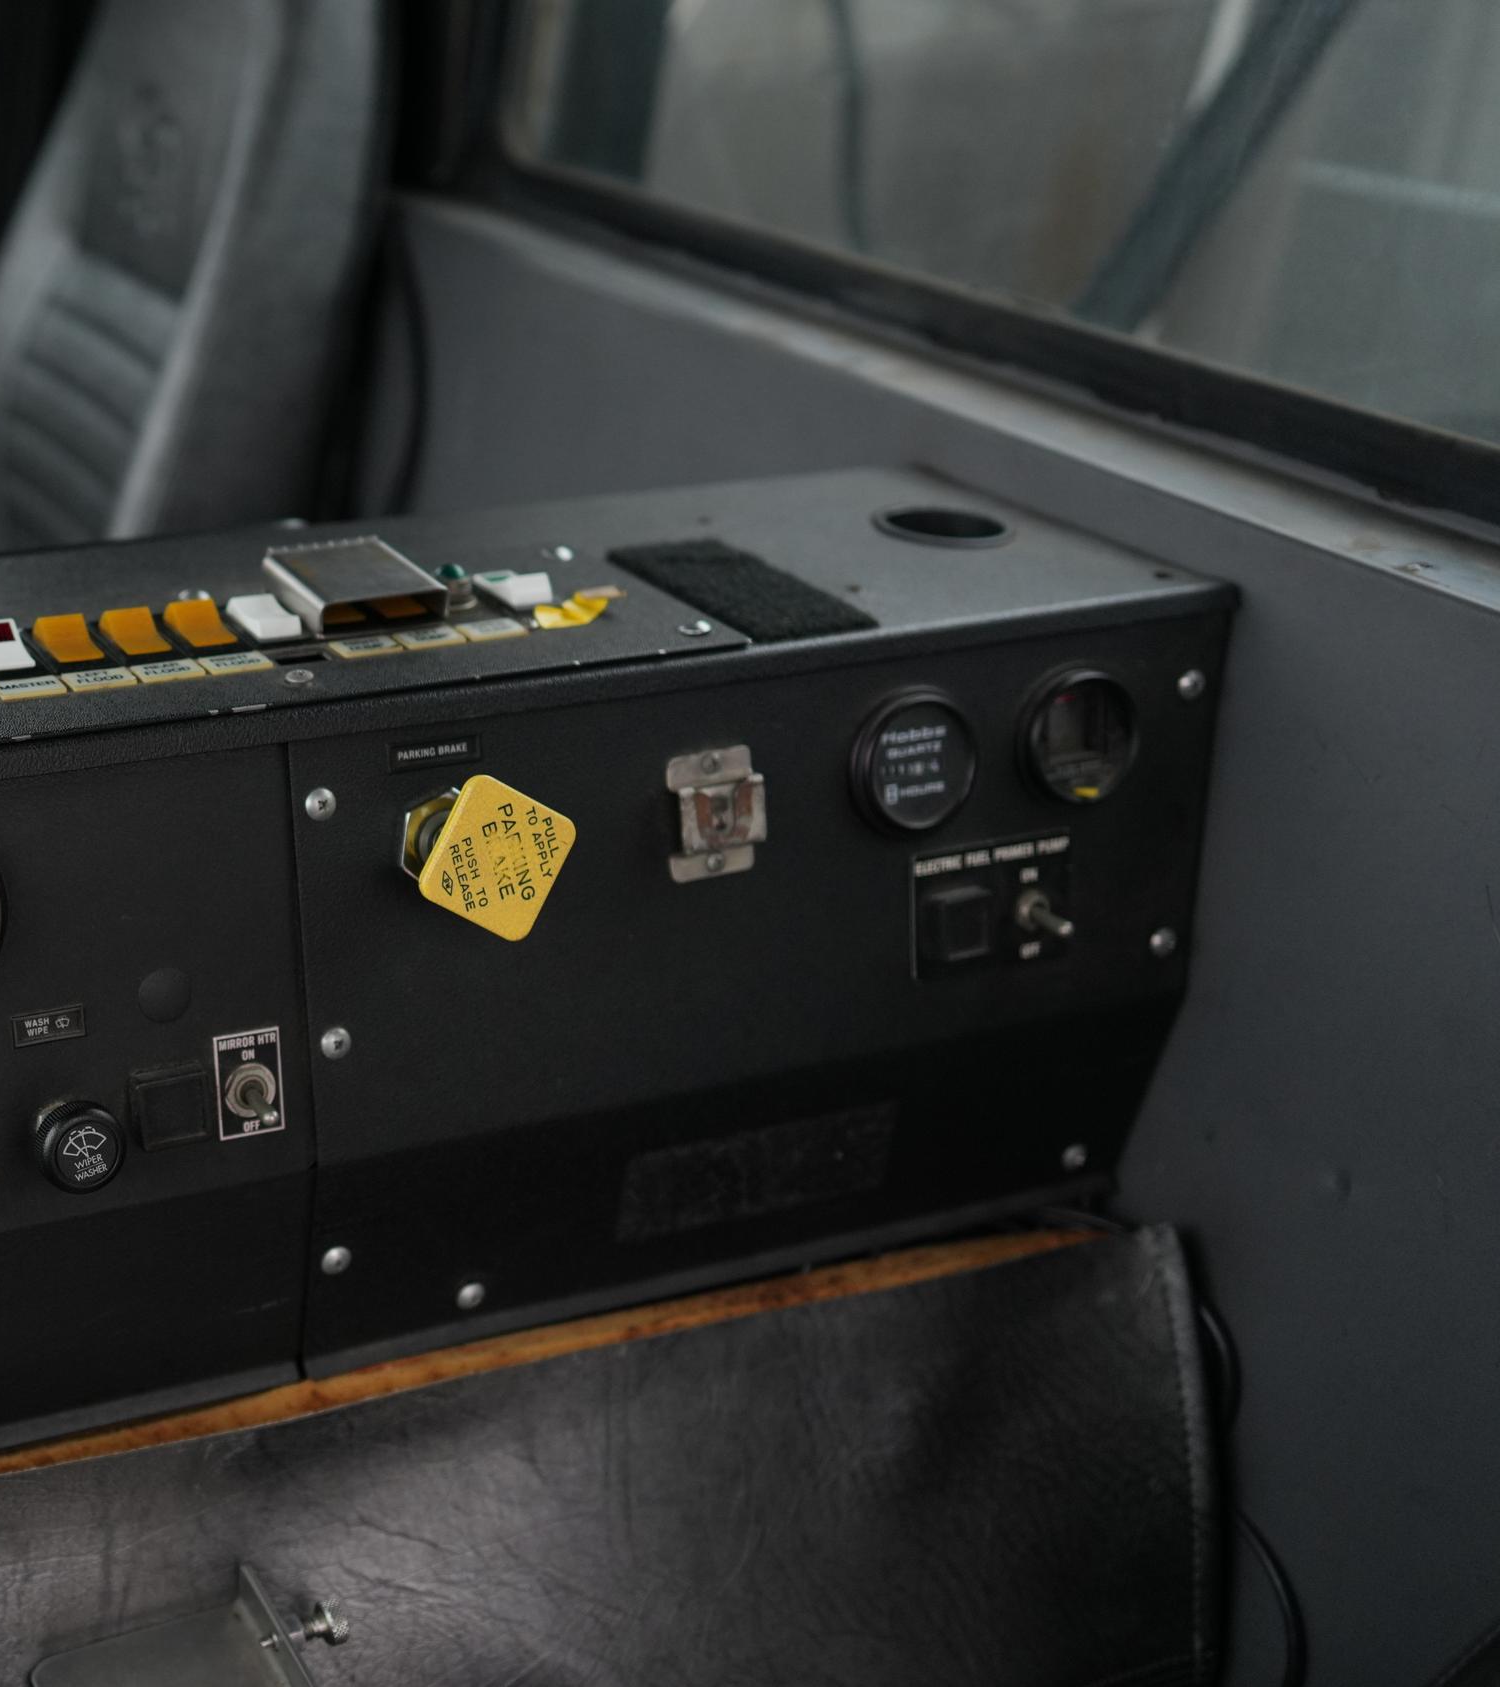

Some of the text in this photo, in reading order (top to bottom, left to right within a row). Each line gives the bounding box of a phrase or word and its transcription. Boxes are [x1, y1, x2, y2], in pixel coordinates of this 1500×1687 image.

[77, 674, 124, 685] FLOOD
[144, 666, 191, 676] FLOOD
[0, 680, 56, 691] MASTER
[398, 742, 468, 761] PARKING BRAKE
[526, 806, 553, 879] TO APPLY
[542, 817, 560, 858] PULL
[915, 854, 963, 877] ELECTRIC
[964, 849, 991, 868] FUEL
[449, 845, 476, 912] RELEASE
[462, 836, 489, 908] PUSH TO
[1020, 867, 1039, 883] ON
[1019, 942, 1041, 960] OFF
[24, 1017, 50, 1029] WASH
[27, 1026, 49, 1037] WIPE
[219, 1032, 277, 1052] MIRROR HTR
[241, 1049, 255, 1061] ON
[243, 1120, 261, 1133] OFF
[74, 1153, 104, 1170] WIPER
[75, 1163, 108, 1182] WASHER
